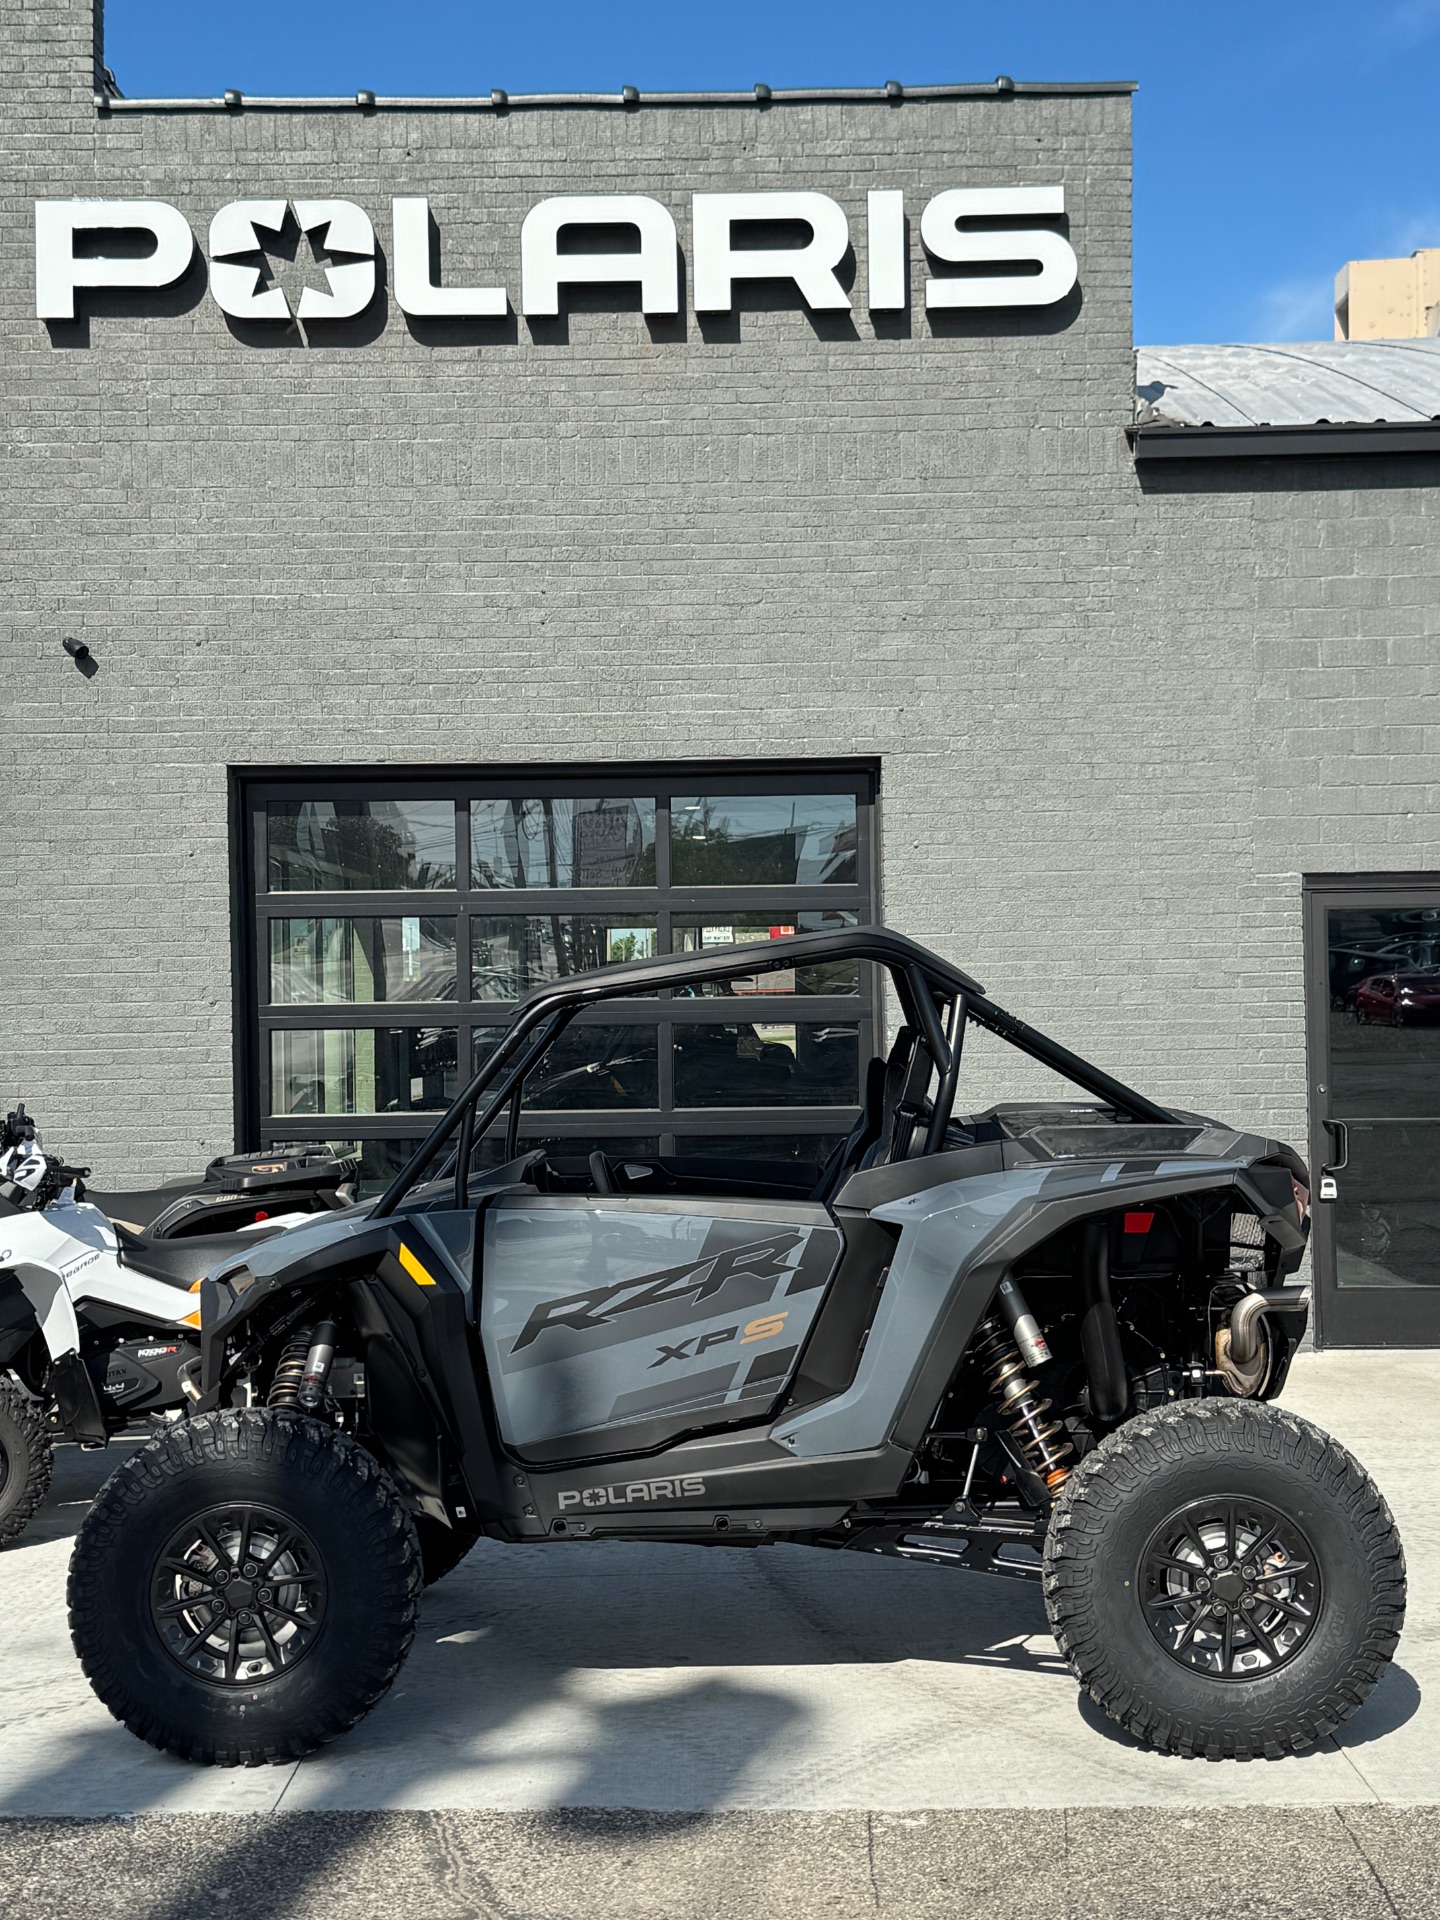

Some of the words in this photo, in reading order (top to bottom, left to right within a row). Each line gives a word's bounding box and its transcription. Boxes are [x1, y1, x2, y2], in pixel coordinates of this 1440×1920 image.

[36, 186, 1077, 318] POLARIS
[508, 1232, 804, 1356] RZR
[137, 1346, 177, 1358] 1000R
[557, 1477, 706, 1510] POLARIS
